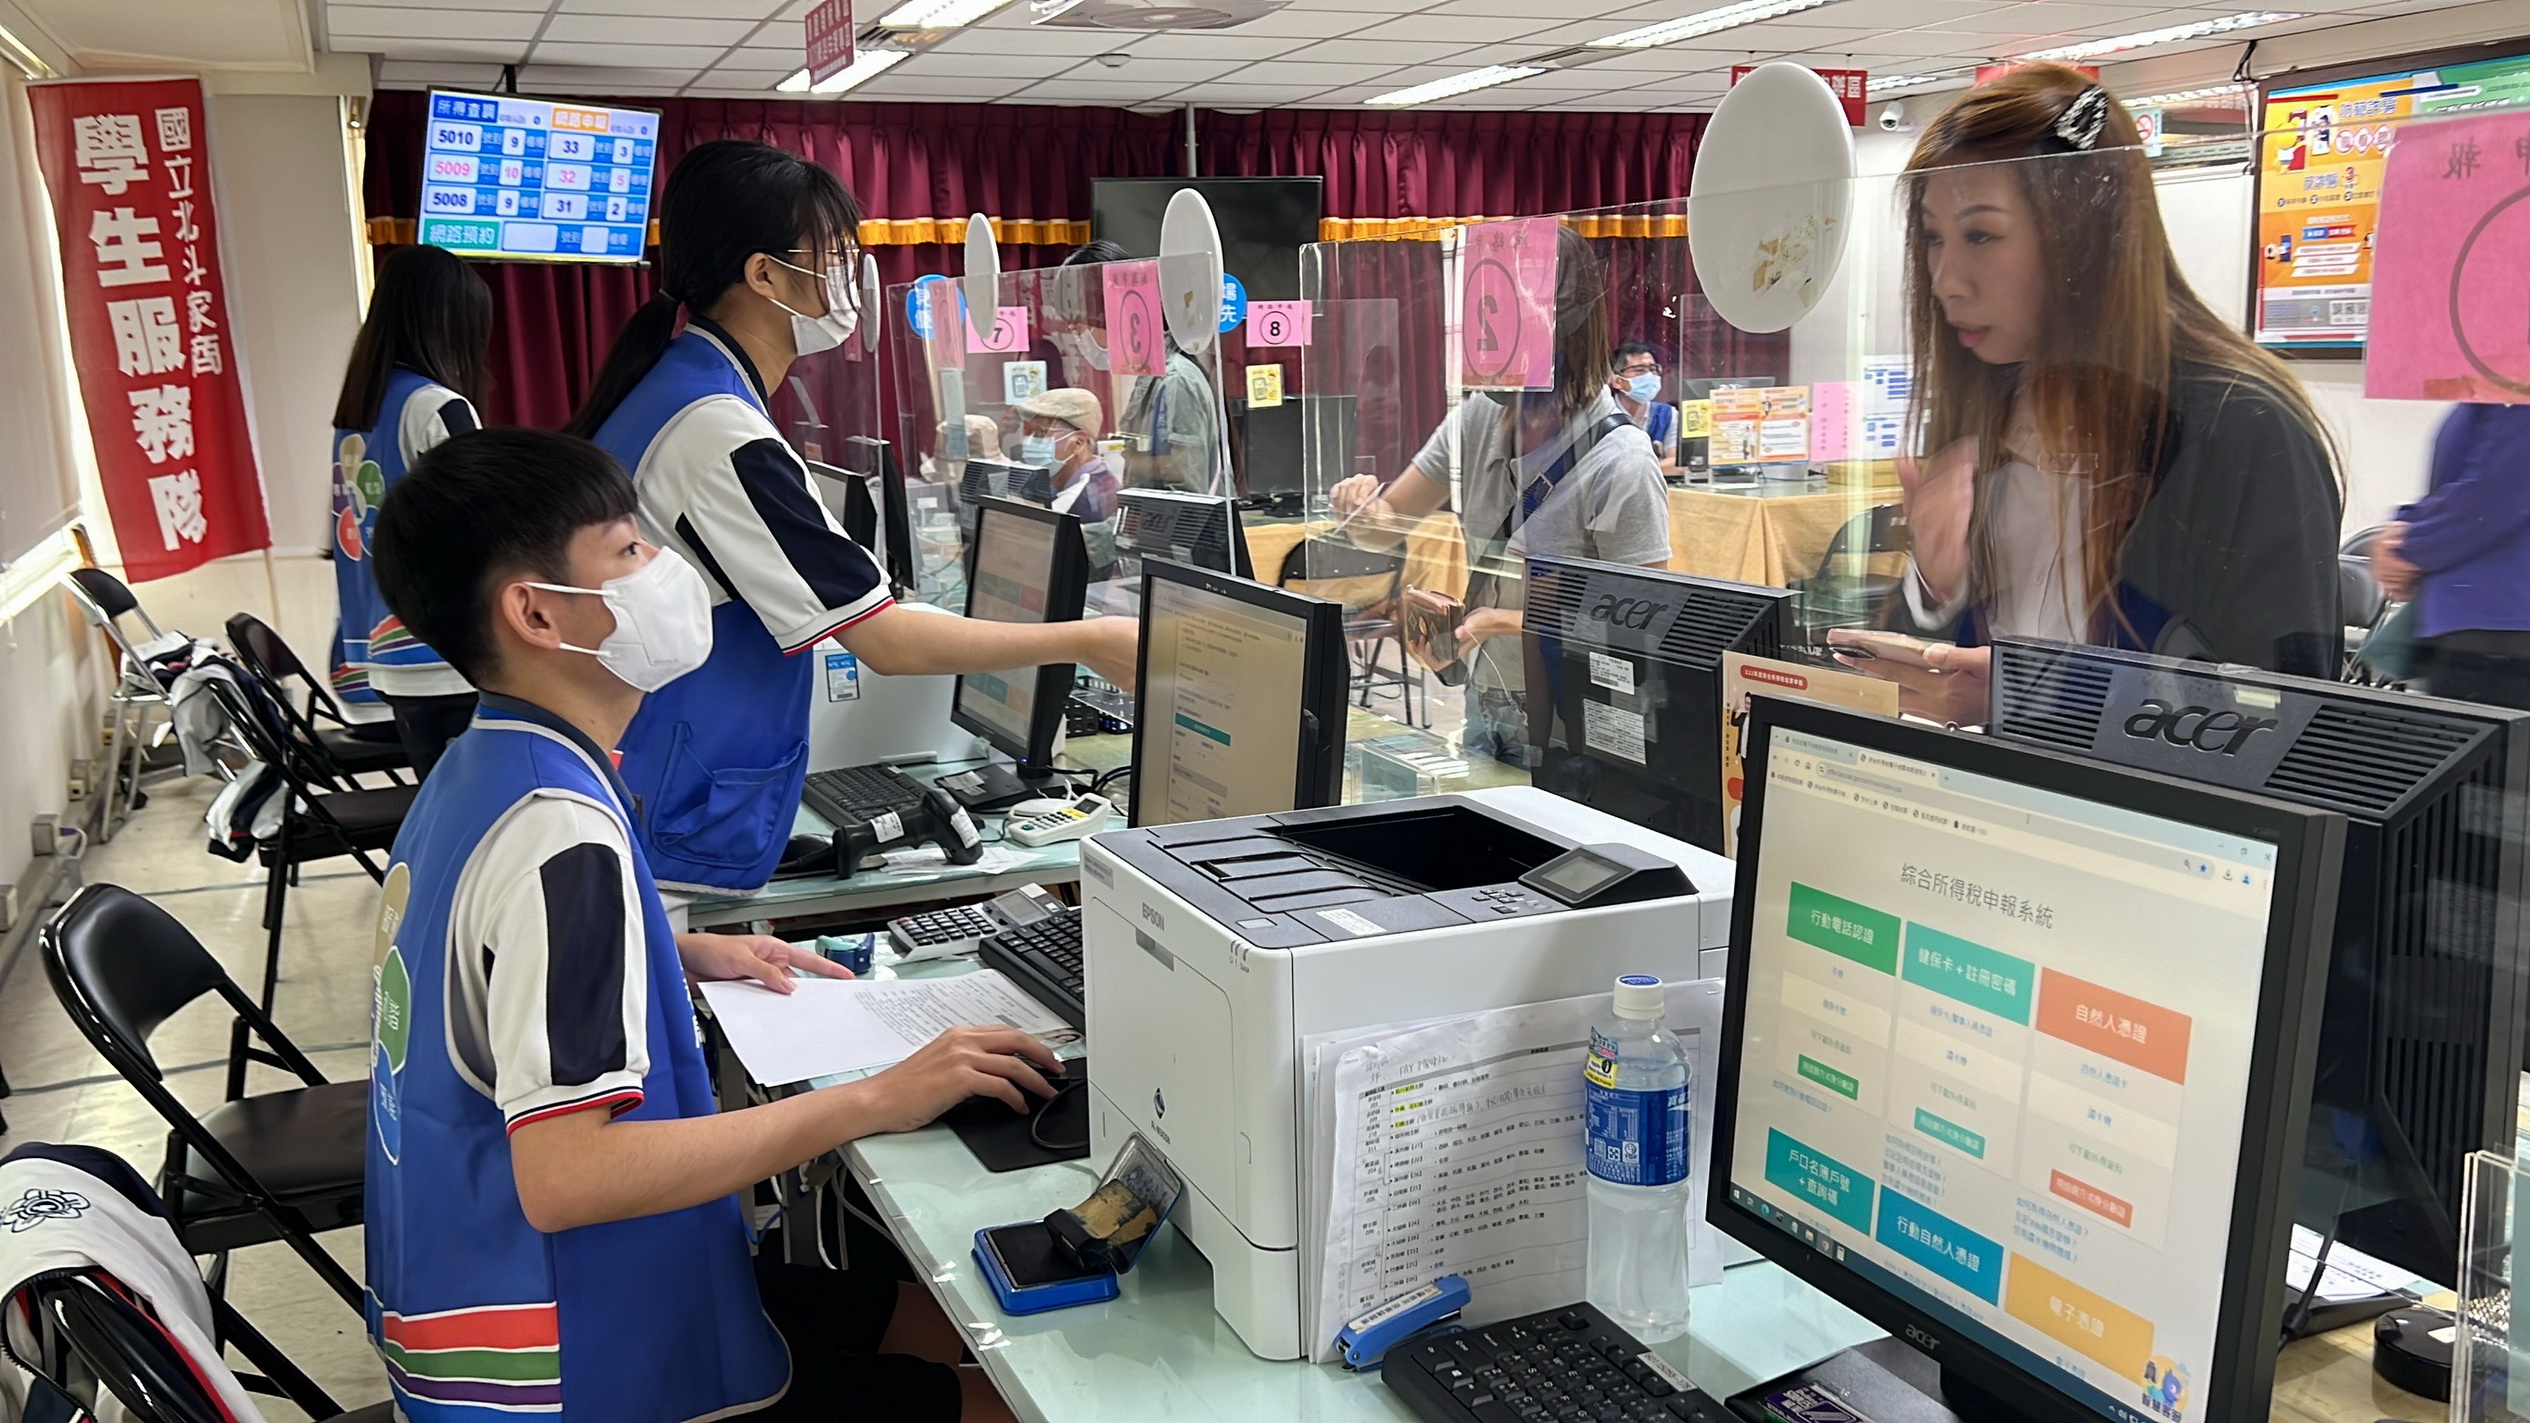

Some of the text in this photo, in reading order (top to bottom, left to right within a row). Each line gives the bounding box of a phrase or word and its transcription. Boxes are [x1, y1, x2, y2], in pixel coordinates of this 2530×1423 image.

[438, 129, 474, 145] 5010
[511, 136, 519, 148] 9
[562, 141, 579, 154] 33
[620, 146, 628, 157] 3
[435, 161, 471, 176] 5009
[505, 167, 519, 178] 10
[559, 170, 577, 183] 32
[616, 175, 625, 186] 5
[433, 192, 468, 206] 5008
[505, 197, 512, 209] 9
[556, 200, 572, 212] 31
[612, 203, 620, 215] 2
[154, 107, 222, 378] 國立北斗家商
[1222, 283, 1237, 302] 場
[1219, 304, 1237, 322] 先
[73, 114, 207, 551] 學生服務隊
[993, 327, 1003, 343] 7
[1270, 321, 1280, 336] 8
[1590, 594, 1669, 630] acer
[2122, 698, 2279, 758] acer
[1901, 863, 2054, 929] 綜合所得稅申報系統
[1142, 902, 1165, 931] EPSON
[1811, 909, 1875, 945] 行動電話認證
[1918, 947, 1954, 973] 健保卡
[1965, 964, 2017, 997] 註冊密碼
[2075, 1004, 2148, 1044] 自然人憑證
[1788, 1149, 1850, 1193] 戶口名簿戶號
[1807, 1178, 1838, 1206] 查詢碼
[1897, 1215, 1980, 1273] 行動自然人憑證
[2050, 1295, 2104, 1338] 電子憑證
[1906, 1323, 1940, 1351] acer
